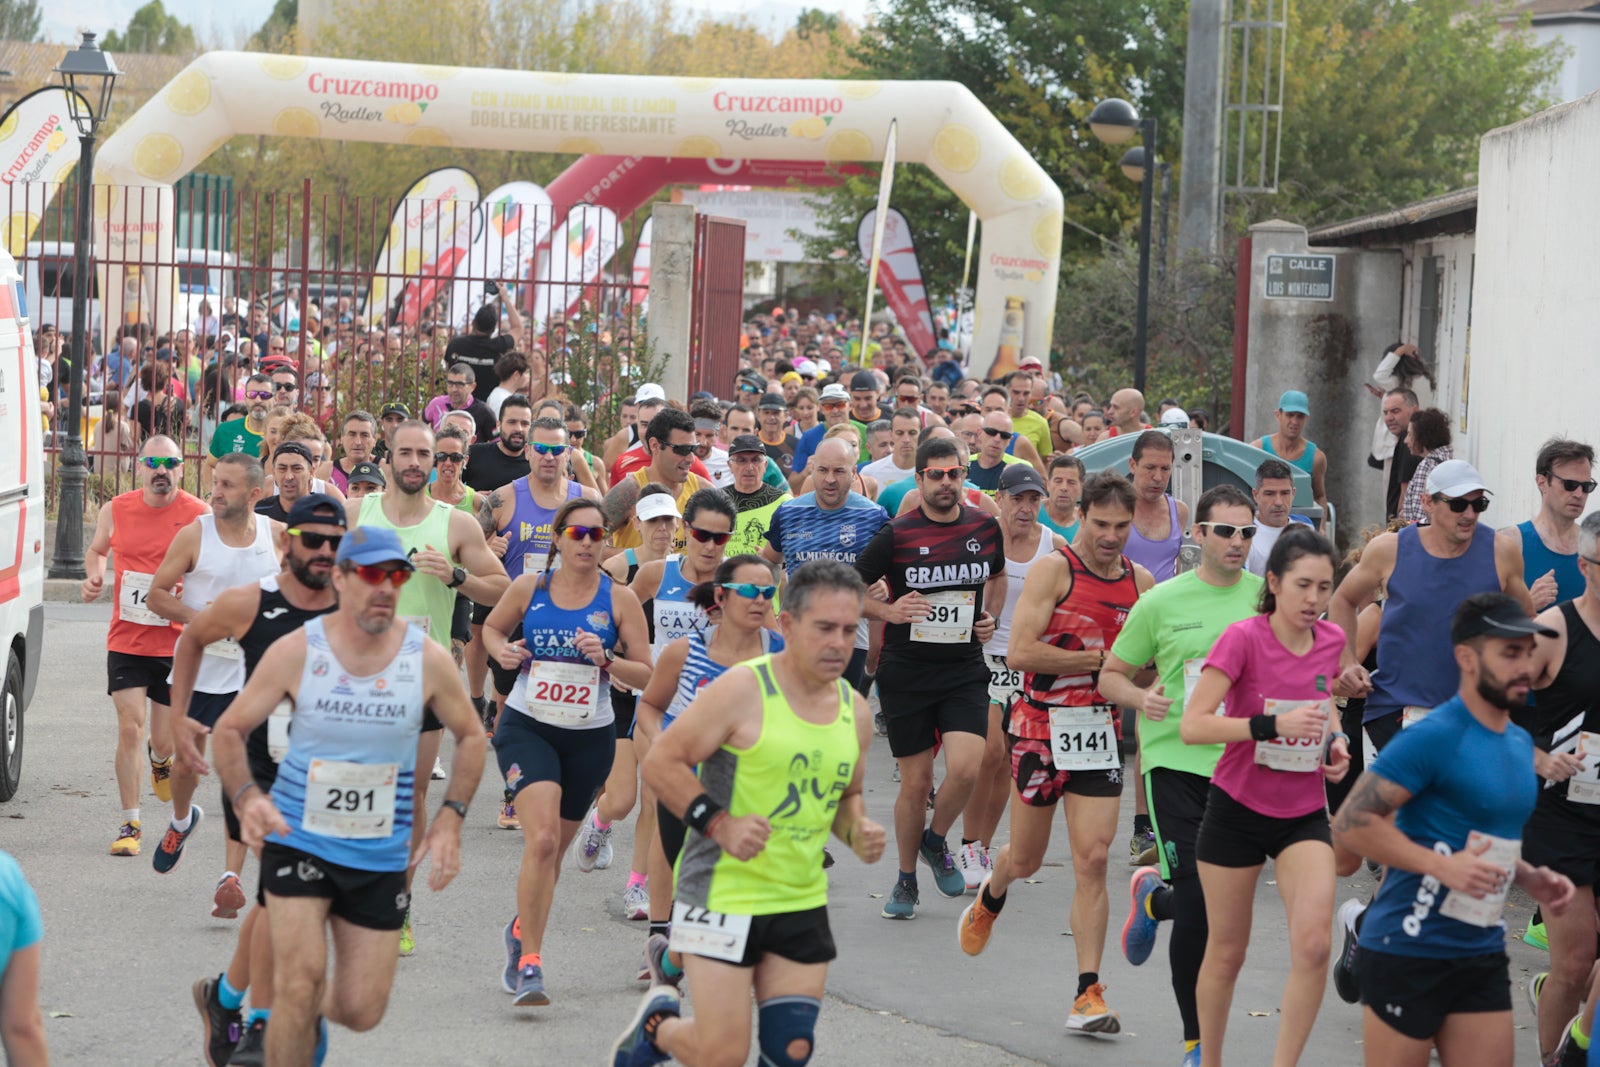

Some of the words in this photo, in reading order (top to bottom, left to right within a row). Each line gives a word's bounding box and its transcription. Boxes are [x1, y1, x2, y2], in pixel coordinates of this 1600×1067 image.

[308, 71, 439, 102] Cruzcampo
[320, 101, 384, 123] Radler
[471, 90, 498, 107] CON
[503, 92, 541, 109] ZUMO
[546, 94, 607, 112] NATURAL
[611, 96, 628, 113] DE
[713, 91, 843, 116] Cruzcampo
[471, 110, 569, 131] DOBLEMENTE
[573, 114, 677, 135] REFRESCANTE
[725, 118, 788, 141] Radler
[1, 114, 60, 186] Cruzcampo
[990, 252, 1050, 270] Cruzcampo
[1289, 259, 1327, 270] CALLE
[1268, 280, 1284, 295] LUIS
[1287, 281, 1330, 297] MONTEAGUDO
[795, 548, 857, 563] ALMUÑÉCAR
[905, 561, 990, 584] GRANADA
[991, 670, 1020, 686] 226
[535, 680, 591, 705] 2022
[314, 698, 406, 718] MARACENA
[1059, 731, 1108, 752] 3141
[325, 788, 375, 812] 291
